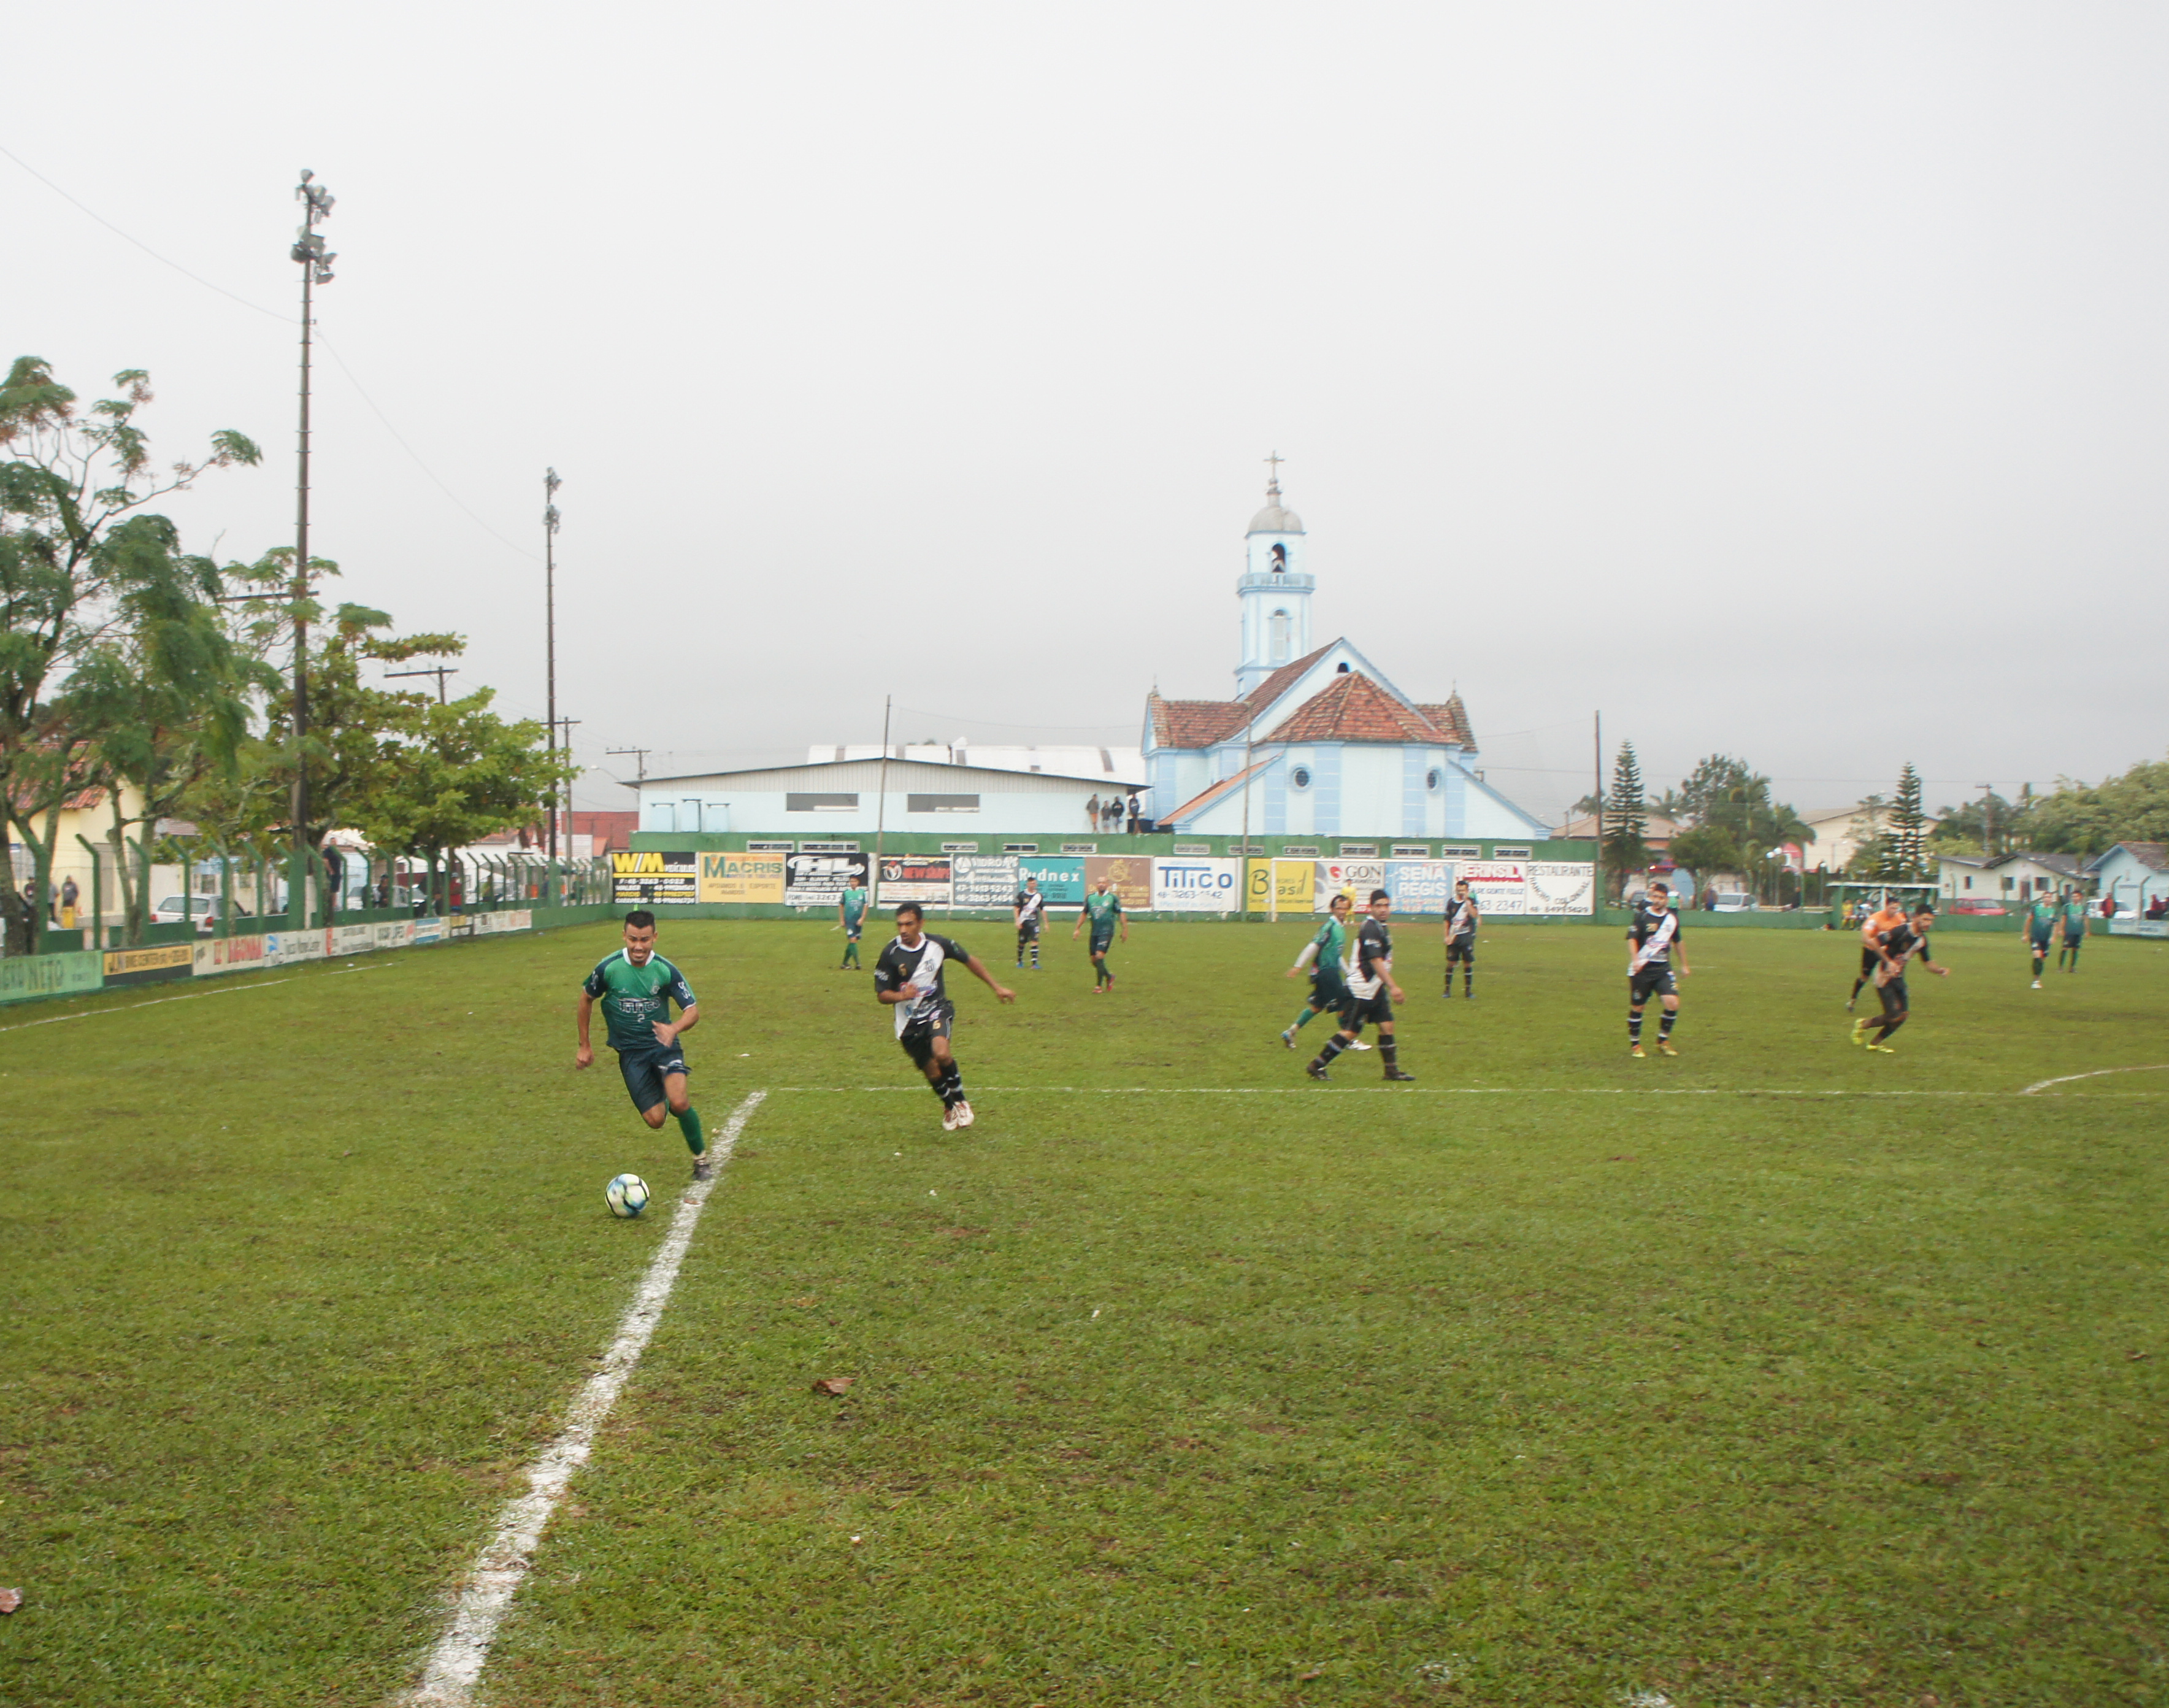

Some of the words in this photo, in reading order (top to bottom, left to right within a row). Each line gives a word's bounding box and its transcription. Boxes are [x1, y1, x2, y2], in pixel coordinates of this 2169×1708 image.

[704, 856, 782, 878] MACRIS
[1346, 866, 1383, 878] GON
[1399, 866, 1446, 881] SENA
[1527, 865, 1594, 877] RESTAURANTE
[1019, 868, 1080, 882] Rudnex
[1399, 882, 1447, 896] REGIS
[932, 1020, 941, 1030] 6
